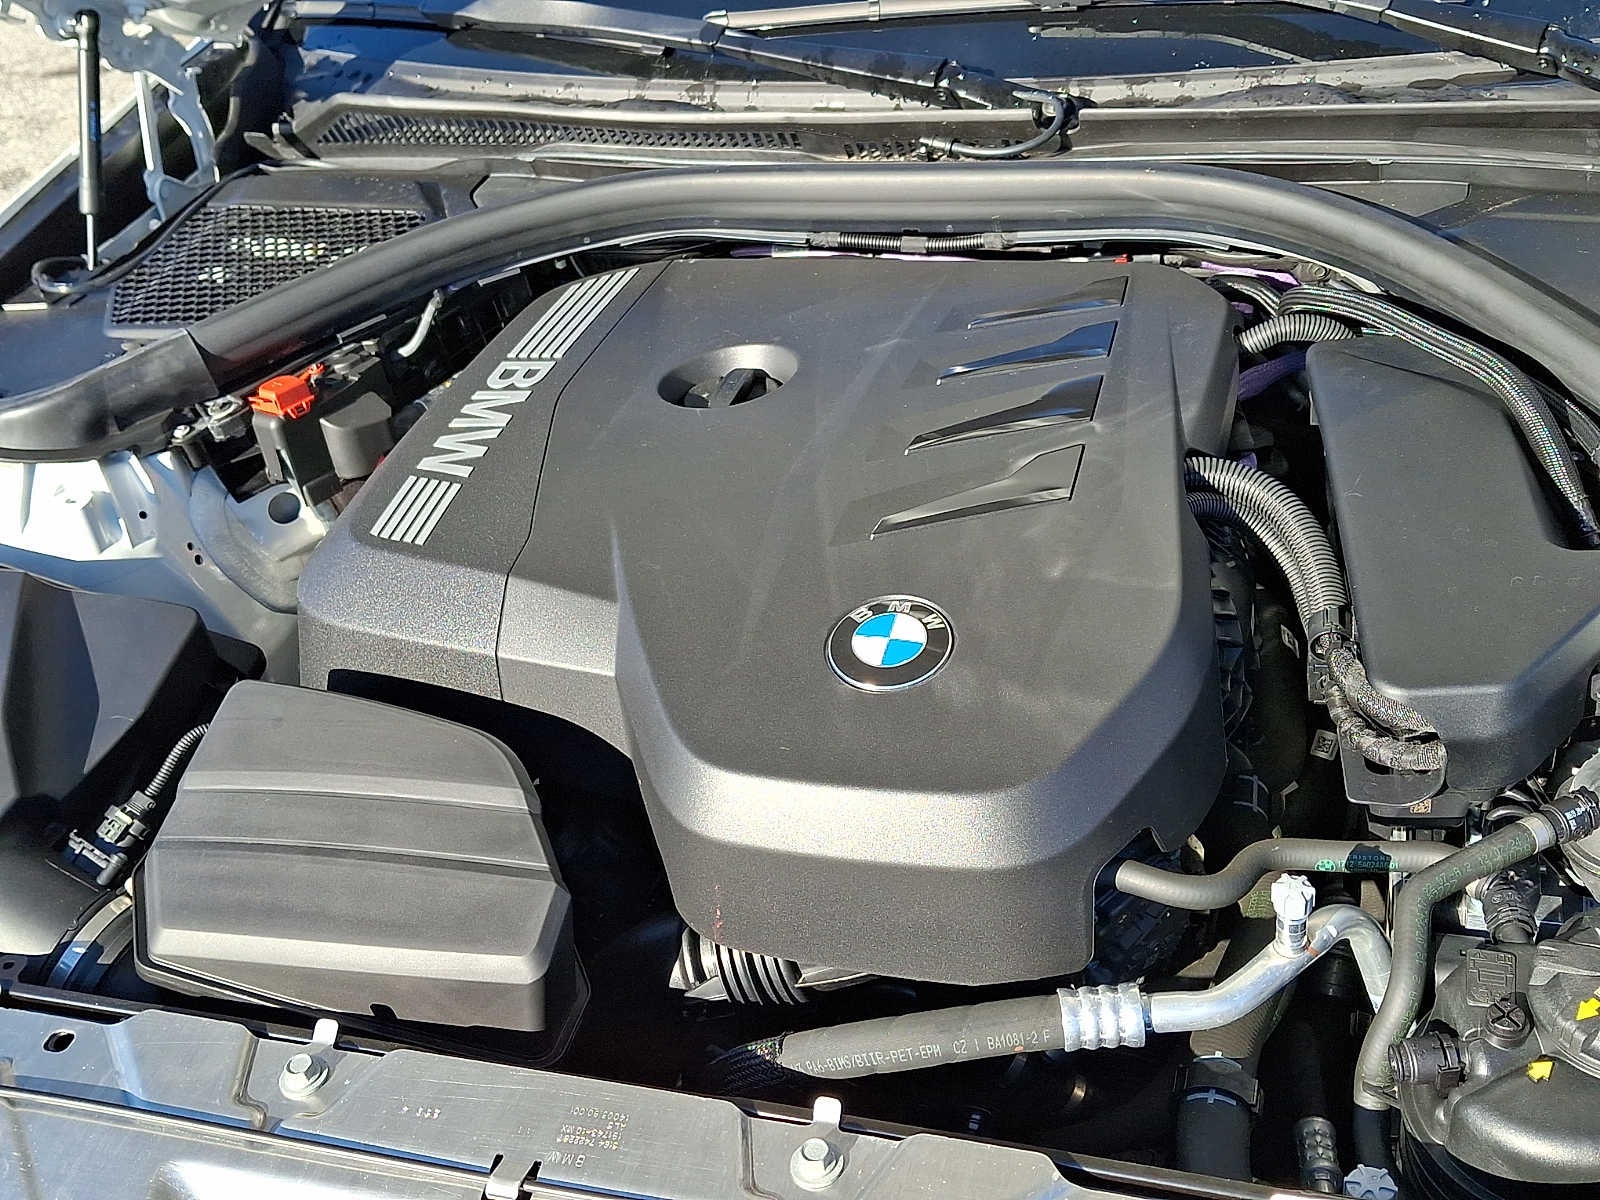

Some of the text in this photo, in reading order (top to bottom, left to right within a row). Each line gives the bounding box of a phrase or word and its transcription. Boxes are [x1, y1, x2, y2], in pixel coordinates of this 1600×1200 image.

[416, 361, 557, 478] BMW
[848, 600, 945, 630] BMW
[546, 1151, 586, 1168] BMW
